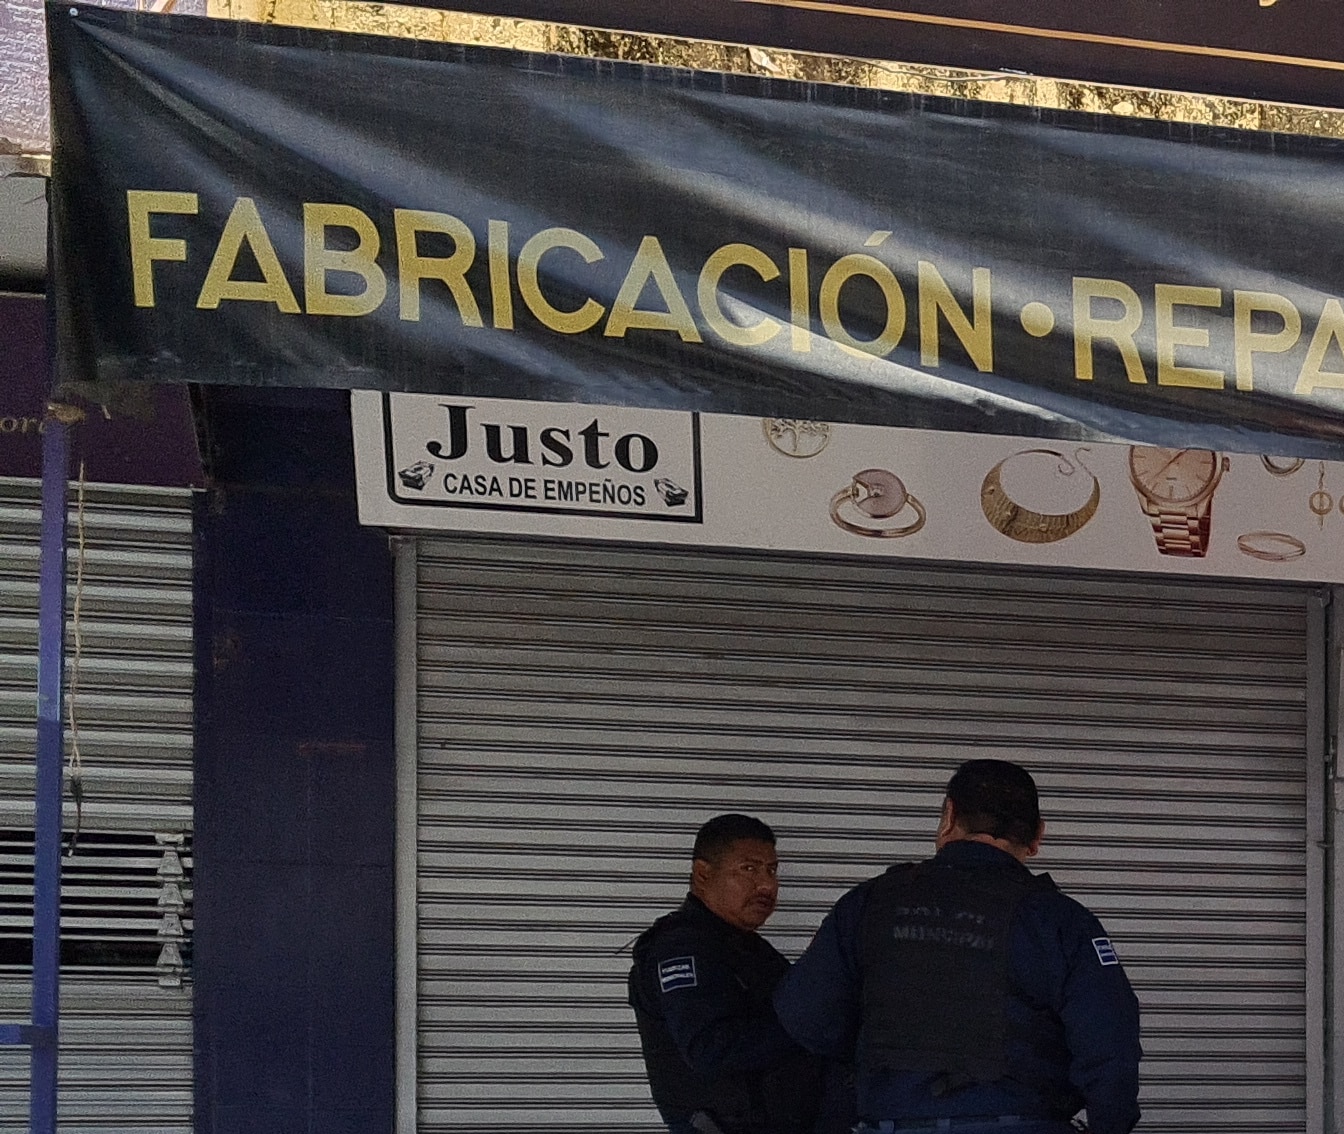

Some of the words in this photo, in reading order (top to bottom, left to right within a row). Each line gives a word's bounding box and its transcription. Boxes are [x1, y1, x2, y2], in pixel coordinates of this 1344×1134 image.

[127, 189, 994, 373] FABRICACIÓN
[425, 402, 660, 474] Justo
[443, 472, 503, 499] CASA
[508, 477, 537, 500] DE
[543, 478, 646, 507] EMPEÑOS
